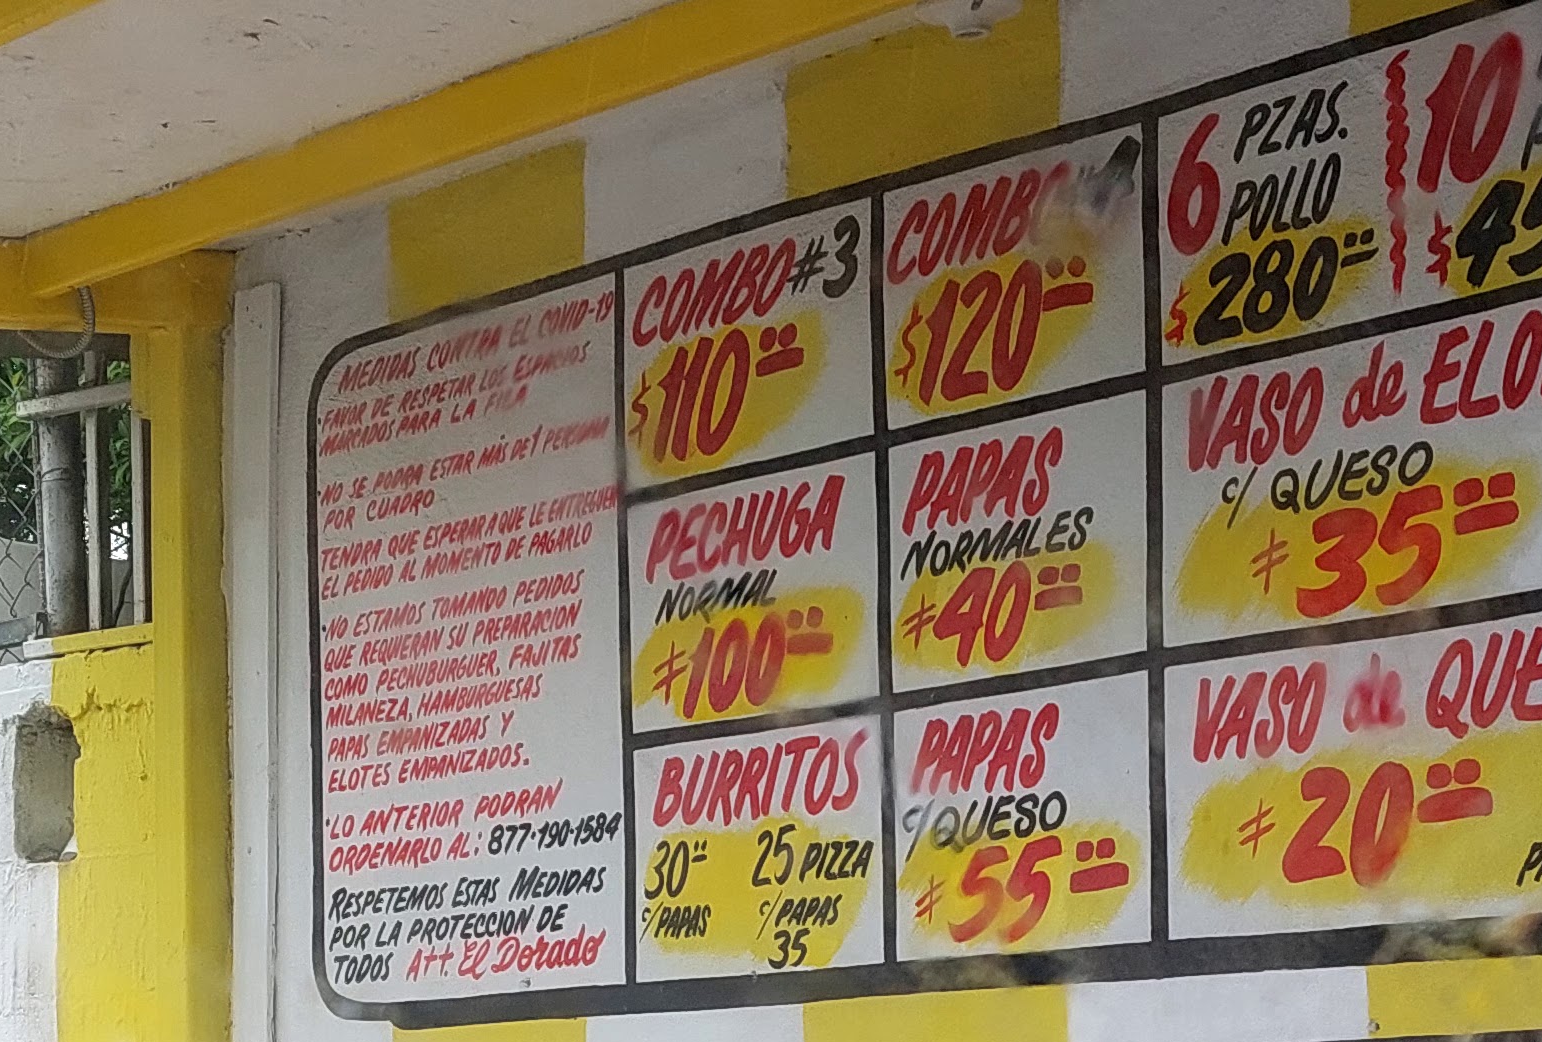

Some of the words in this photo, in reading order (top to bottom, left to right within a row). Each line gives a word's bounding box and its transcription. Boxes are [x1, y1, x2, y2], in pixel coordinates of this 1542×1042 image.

[1416, 31, 1523, 192] 10
[1167, 112, 1221, 255] 6
[1234, 80, 1348, 164] PZAS.
[1221, 152, 1341, 245] POLLO
[338, 346, 421, 393] MEDIDAS
[427, 325, 502, 372] CONTRA
[510, 315, 531, 348] EL
[539, 291, 613, 336] COVID-19
[319, 420, 395, 457] MARCADOS
[396, 408, 440, 437] PARA
[450, 398, 477, 424] LA
[322, 401, 367, 433] FAVOR
[371, 394, 393, 421] DE
[399, 373, 476, 414] RESPETAR
[1187, 367, 1323, 472] VASO
[1342, 342, 1408, 431] de
[320, 482, 343, 506] NO
[348, 476, 368, 499] SE
[373, 464, 423, 493] PODRA
[430, 450, 474, 481] ESTAR
[510, 438, 530, 460] DE
[902, 426, 1063, 536] PAPAS
[1270, 440, 1434, 513] QUESO
[321, 539, 382, 572] TENDRA
[388, 530, 420, 560] QUE
[423, 515, 485, 551] ESPERAR
[498, 506, 527, 534] QUE
[529, 502, 547, 528] LE
[324, 506, 355, 533] POR
[366, 489, 435, 522] CUADRO
[645, 475, 846, 584] PECHUGA
[900, 506, 1093, 580] NORMALES
[322, 575, 339, 600] EL
[344, 564, 393, 597] PEDIDO
[399, 556, 416, 584] AL
[421, 543, 501, 580] MOMENTO
[505, 535, 526, 561] DE
[529, 522, 592, 558] PAGARLO
[325, 616, 348, 642] NO
[353, 602, 426, 637] ESTAMOS
[433, 586, 507, 621] TOMANDO
[513, 569, 585, 608] PEDIDOS
[655, 569, 777, 626] NORMAL
[325, 645, 356, 672] QUE
[359, 627, 444, 669] REQUIERAN
[448, 622, 468, 650] SU
[473, 599, 582, 646] PREPARACION
[325, 673, 367, 701] COMO
[509, 634, 581, 670] FAJITAS
[417, 674, 543, 719] HAMBURGUESAS
[1192, 661, 1326, 763] VASO
[328, 733, 368, 762] PAPAS
[377, 715, 490, 756] EMPANIZADAS
[501, 710, 514, 737] Y
[329, 762, 391, 793] ELOTES
[399, 743, 529, 784] EMPANIZADOS.
[908, 703, 1059, 795] PAPAS
[330, 815, 354, 840] LO
[360, 799, 463, 837] ANTERIOR
[474, 777, 563, 822] PODRAN
[652, 727, 870, 829] BURRITOS
[329, 837, 442, 876] ORDENARLO
[752, 824, 797, 888] 25
[799, 840, 874, 882] PIZZA
[329, 883, 447, 923] RESPETEMOS
[452, 876, 500, 908] ESTAS
[509, 866, 606, 902] MEDIDAS
[329, 924, 369, 952] POR
[376, 921, 401, 948] LA
[408, 905, 534, 944] PROTECCION
[536, 904, 568, 932] DE
[334, 952, 393, 985] TODOS
[458, 938, 490, 980] El
[492, 923, 606, 973] Dorado
[768, 927, 811, 970] 35
